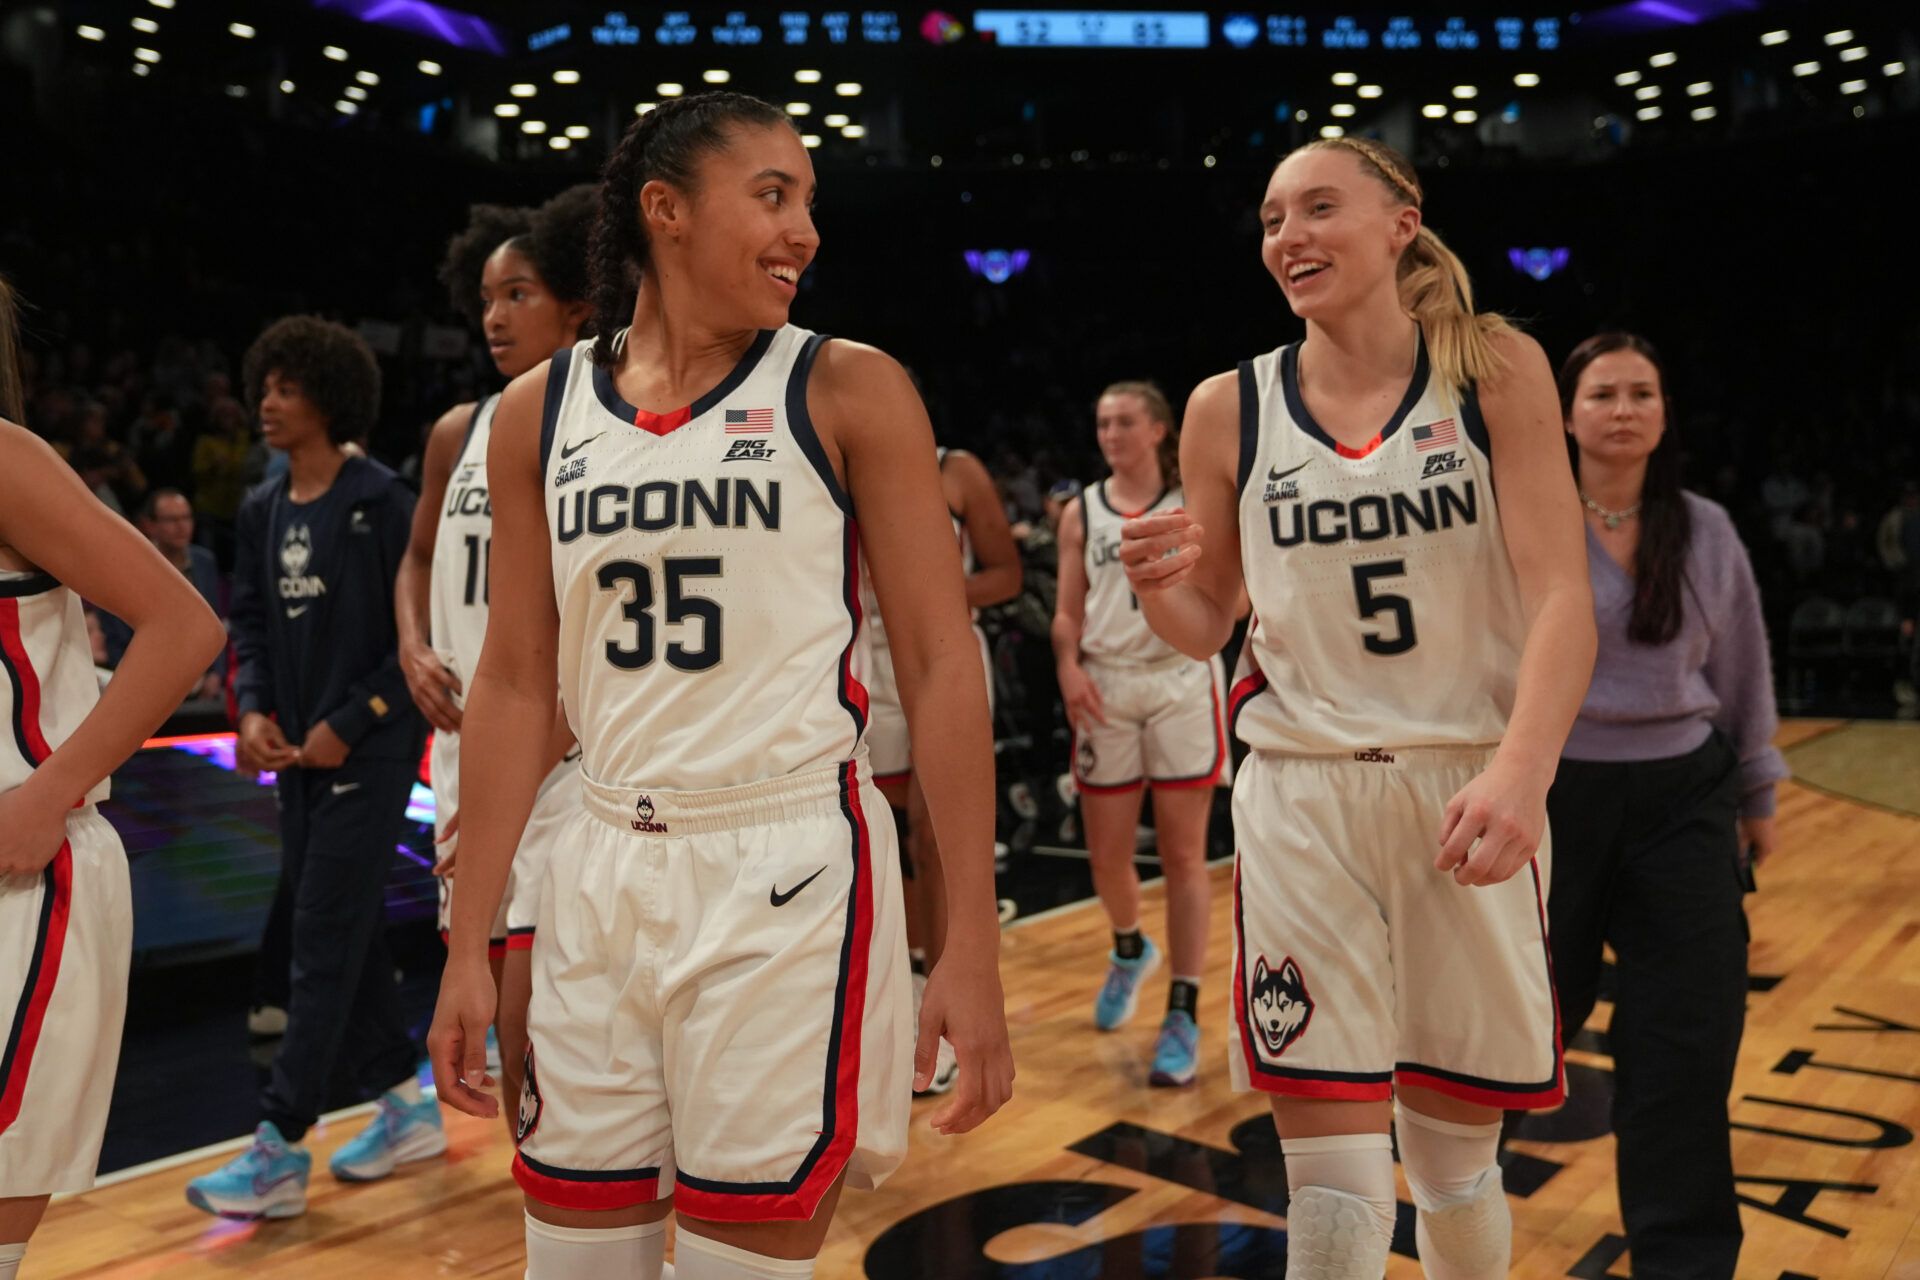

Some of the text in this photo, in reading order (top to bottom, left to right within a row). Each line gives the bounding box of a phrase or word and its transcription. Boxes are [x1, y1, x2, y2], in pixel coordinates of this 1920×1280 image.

[731, 439, 768, 449] BIG
[726, 449, 776, 458] EAST
[1426, 451, 1456, 465] BIG
[558, 457, 588, 474] BE THE
[1423, 458, 1466, 475] EAST
[555, 466, 586, 487] CHANGE
[1266, 480, 1297, 492] BE THE
[1263, 489, 1299, 502] CHANGE
[558, 477, 781, 544] UCONN
[1269, 479, 1478, 548] UCONN
[595, 556, 723, 673] 35
[1352, 558, 1418, 657] 5
[1354, 751, 1394, 763] UCONN
[631, 820, 668, 833] UCONN
